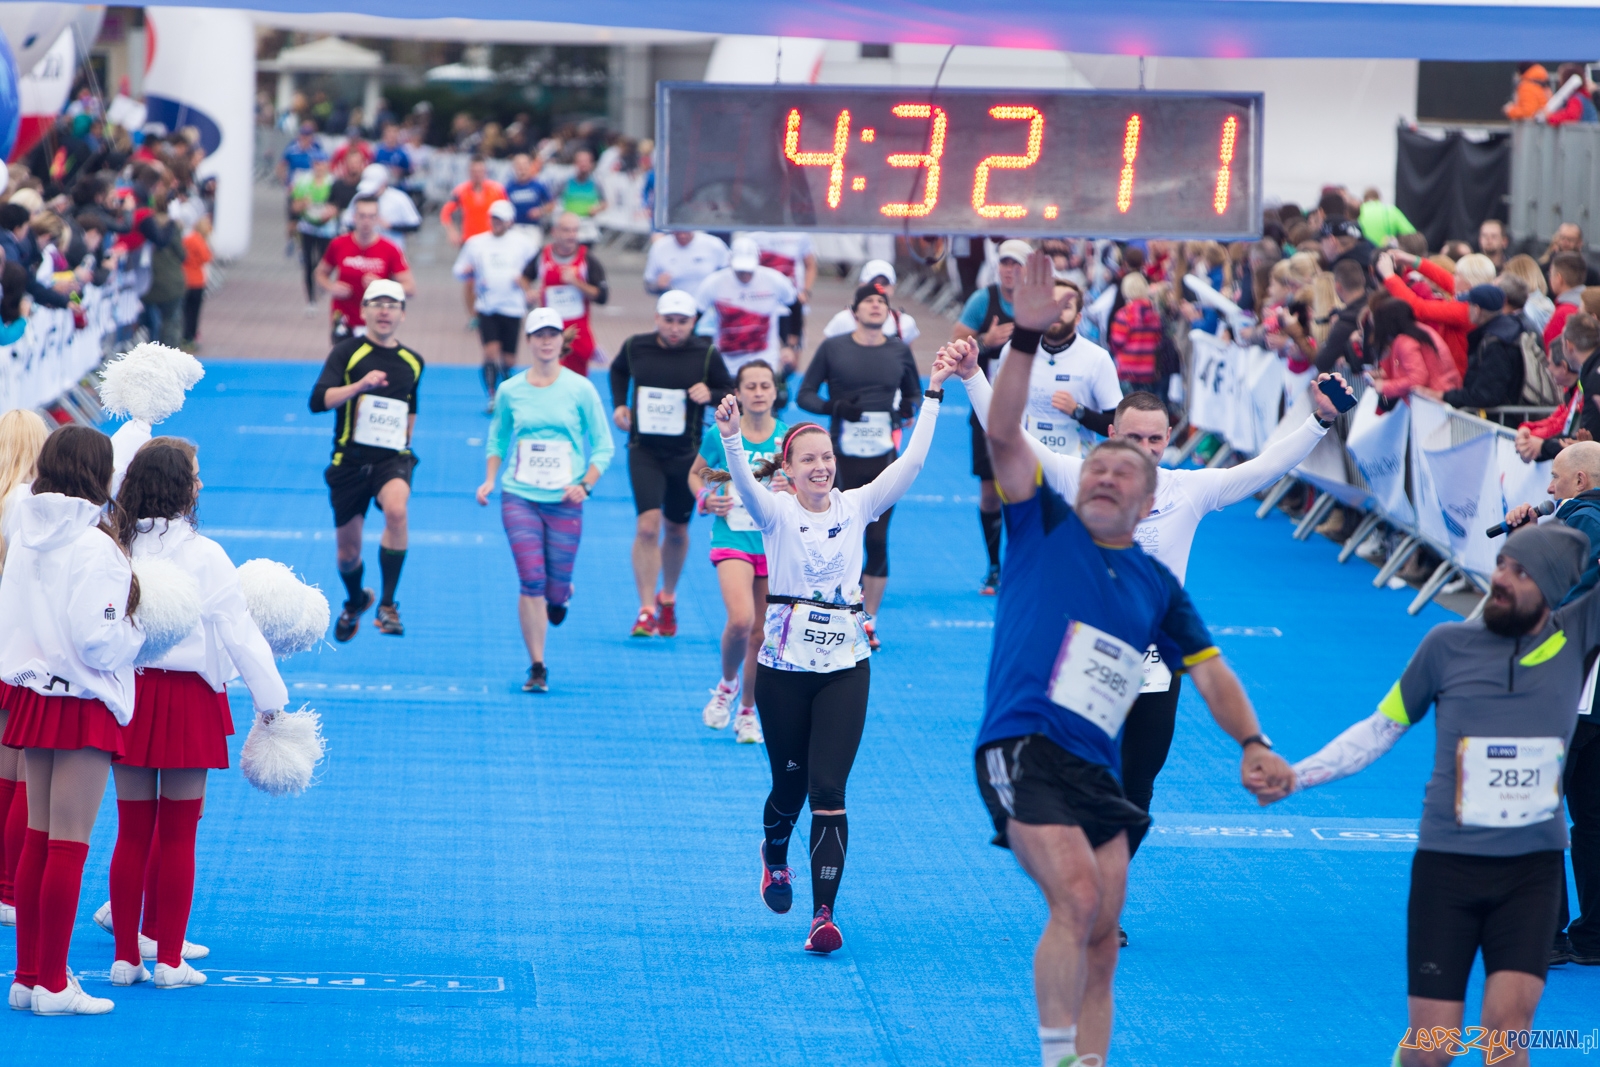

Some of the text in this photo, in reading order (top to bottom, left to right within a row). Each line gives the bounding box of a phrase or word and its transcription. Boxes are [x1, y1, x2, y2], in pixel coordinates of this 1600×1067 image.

[529, 456, 561, 468] 6555
[803, 629, 845, 646] 5379
[1488, 768, 1540, 788] 2821
